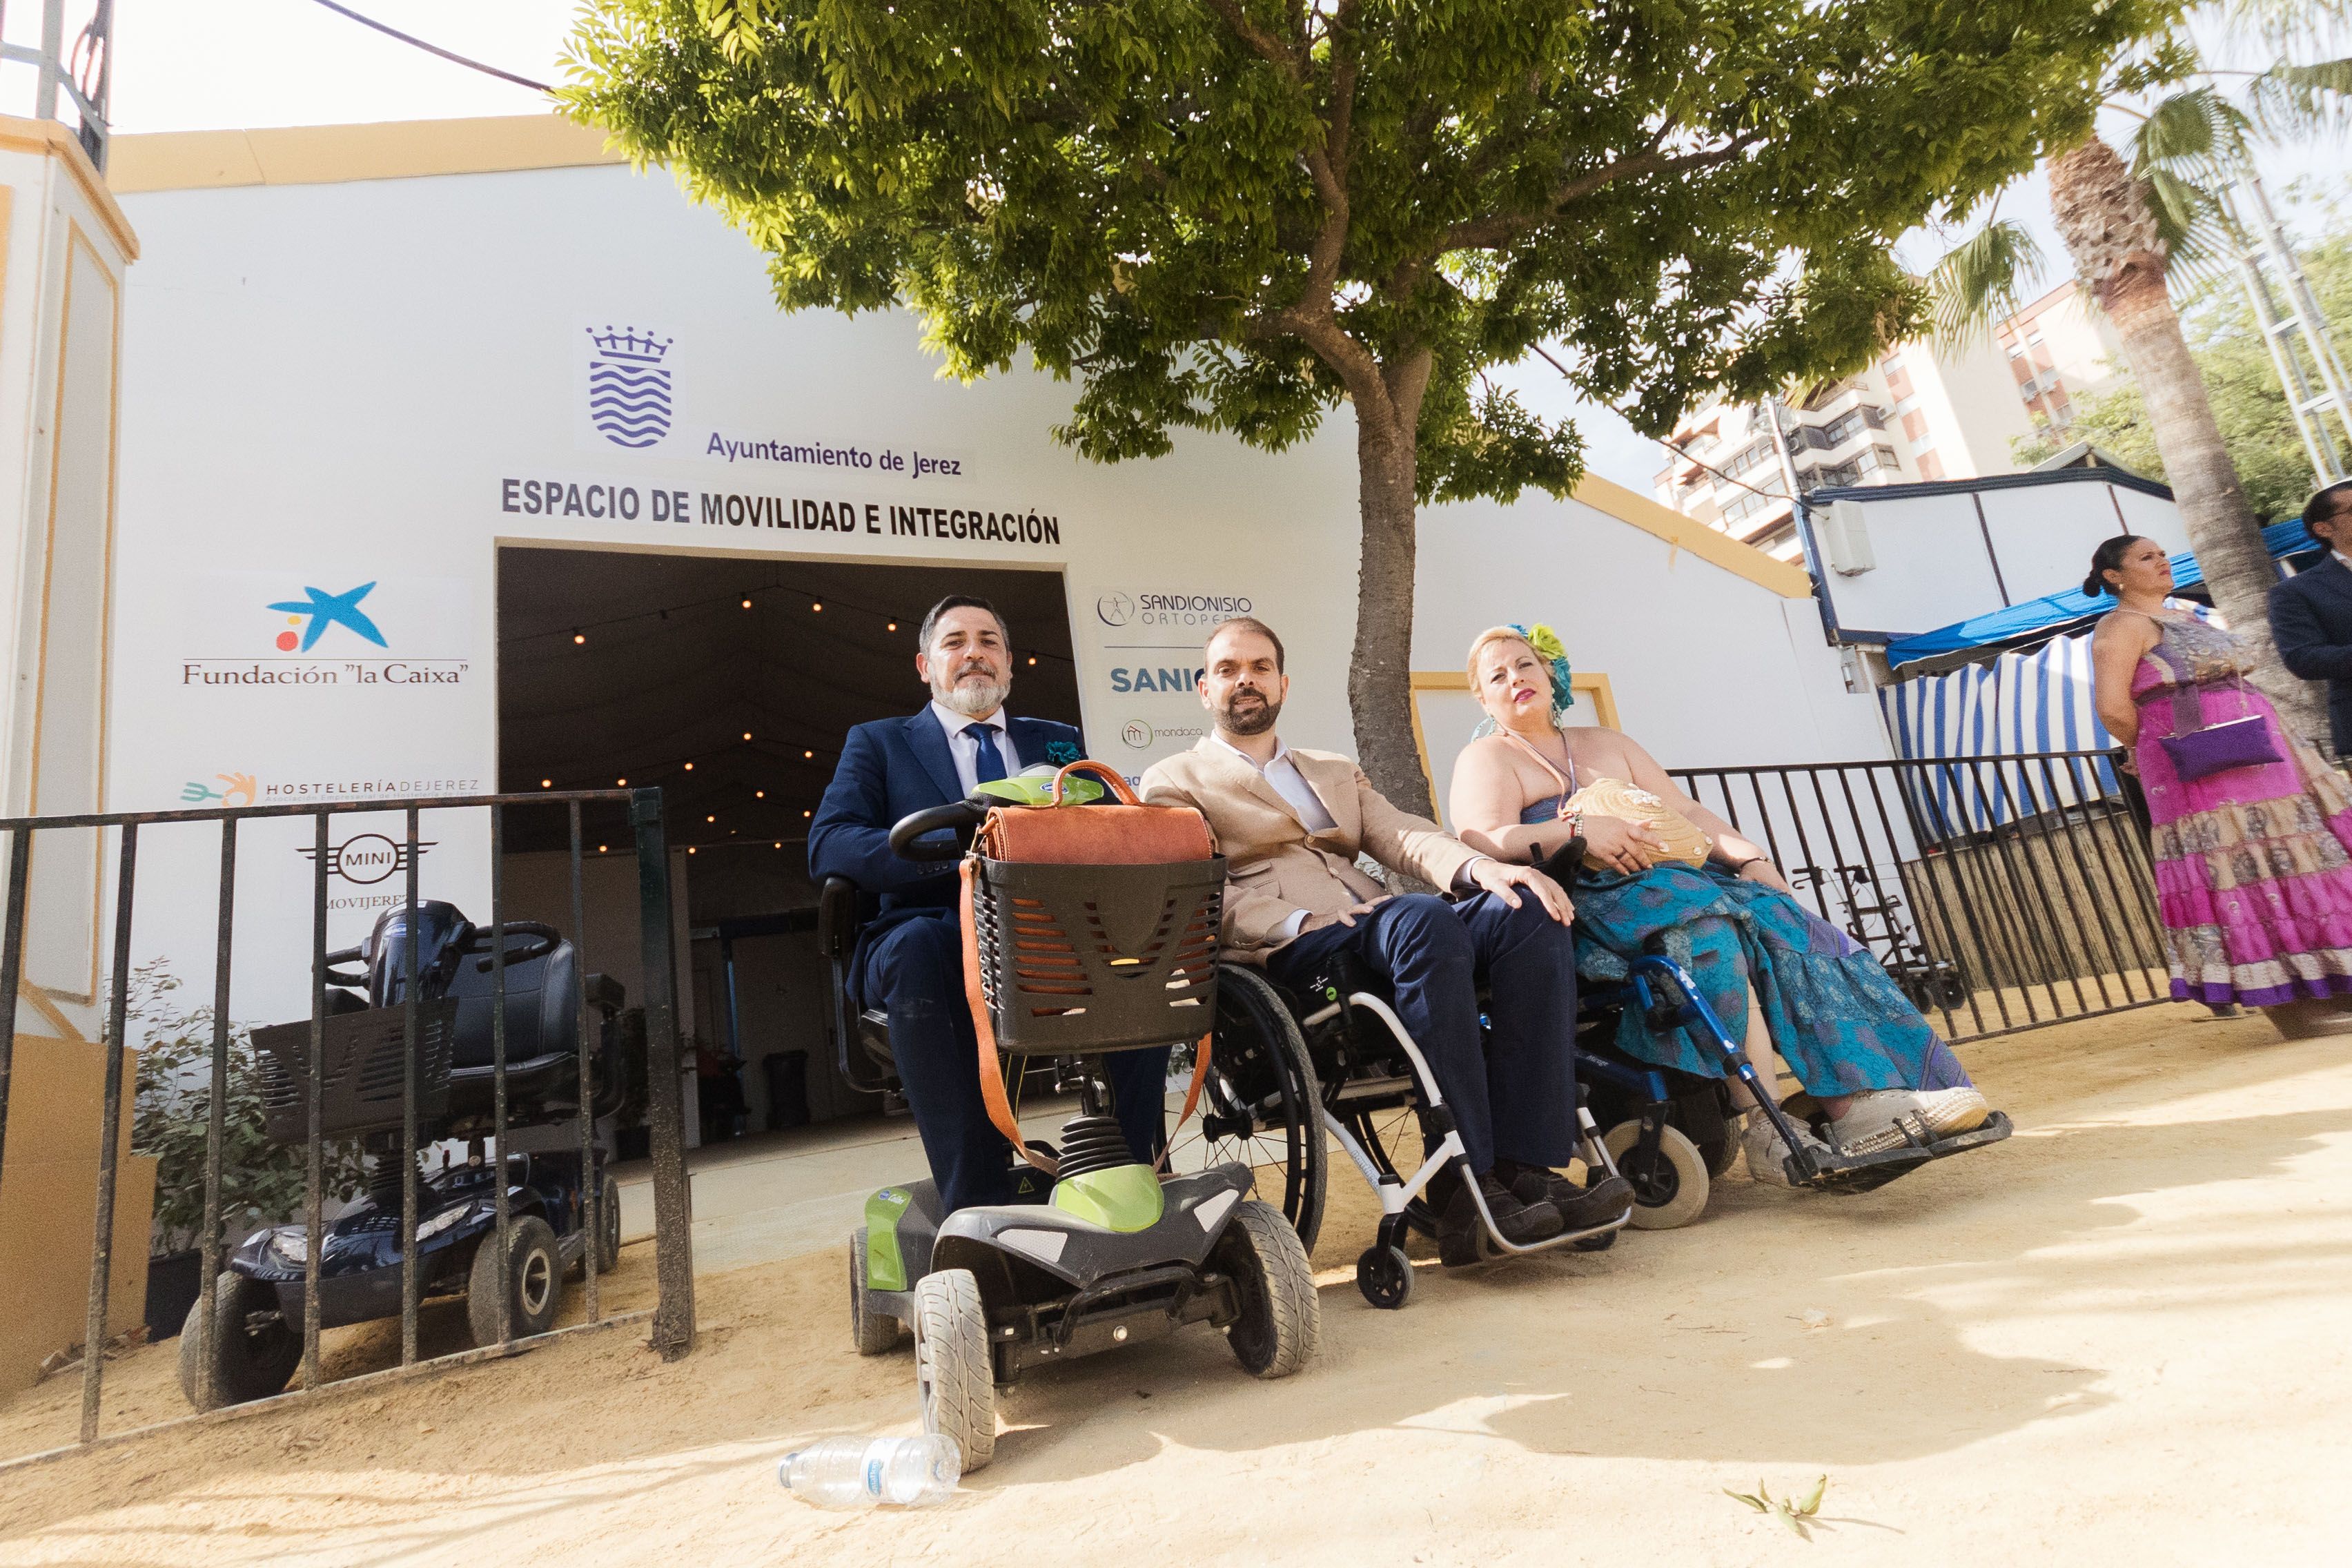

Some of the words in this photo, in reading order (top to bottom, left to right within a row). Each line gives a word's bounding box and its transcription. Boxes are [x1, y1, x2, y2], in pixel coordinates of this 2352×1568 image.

[706, 432, 873, 470] Ayuntamiento
[879, 450, 904, 471] de
[912, 451, 962, 480] Jerez
[502, 478, 640, 521] ESPACIO
[651, 490, 689, 523] DE
[701, 493, 856, 533] MOVILIDAD
[866, 504, 880, 534] E
[890, 507, 1061, 545] INTEGRACIÓN
[1140, 594, 1252, 613] SANDIONISIO
[182, 663, 338, 685] Fundación
[1155, 727, 1203, 737] mondaca
[345, 852, 391, 867] MINI
